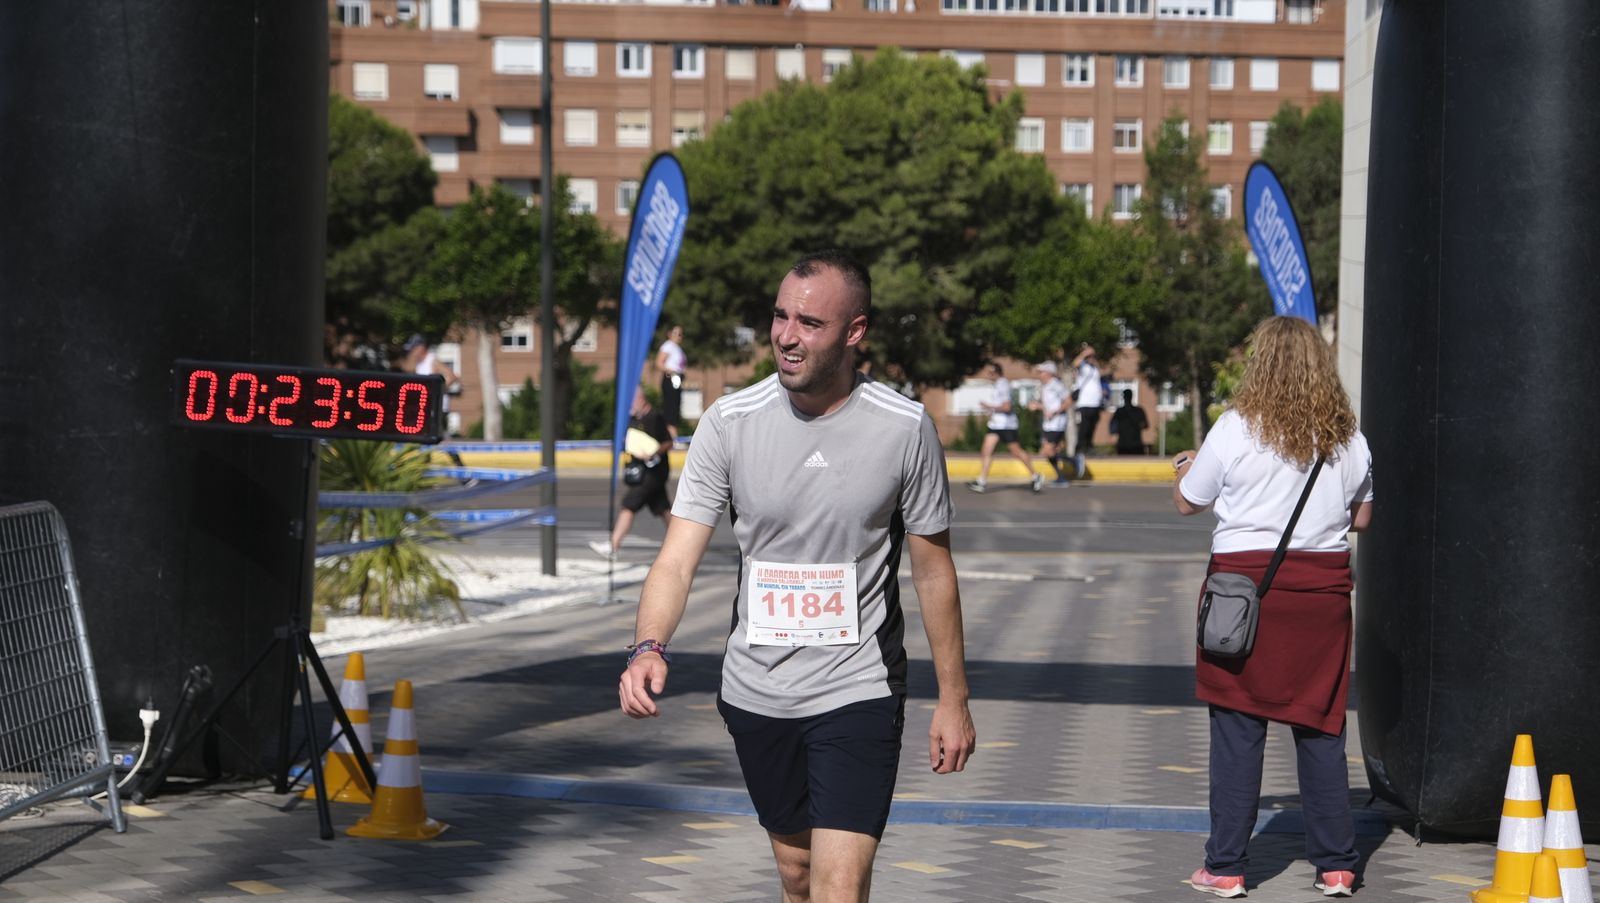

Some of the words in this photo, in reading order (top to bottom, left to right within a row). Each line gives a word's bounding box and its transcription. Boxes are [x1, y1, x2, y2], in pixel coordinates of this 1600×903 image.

[186, 370, 428, 434] 00:23:50
[764, 568, 800, 580] CARRERA
[801, 570, 817, 580] SIN
[819, 569, 845, 580] HUMO
[762, 591, 845, 619] 1184
